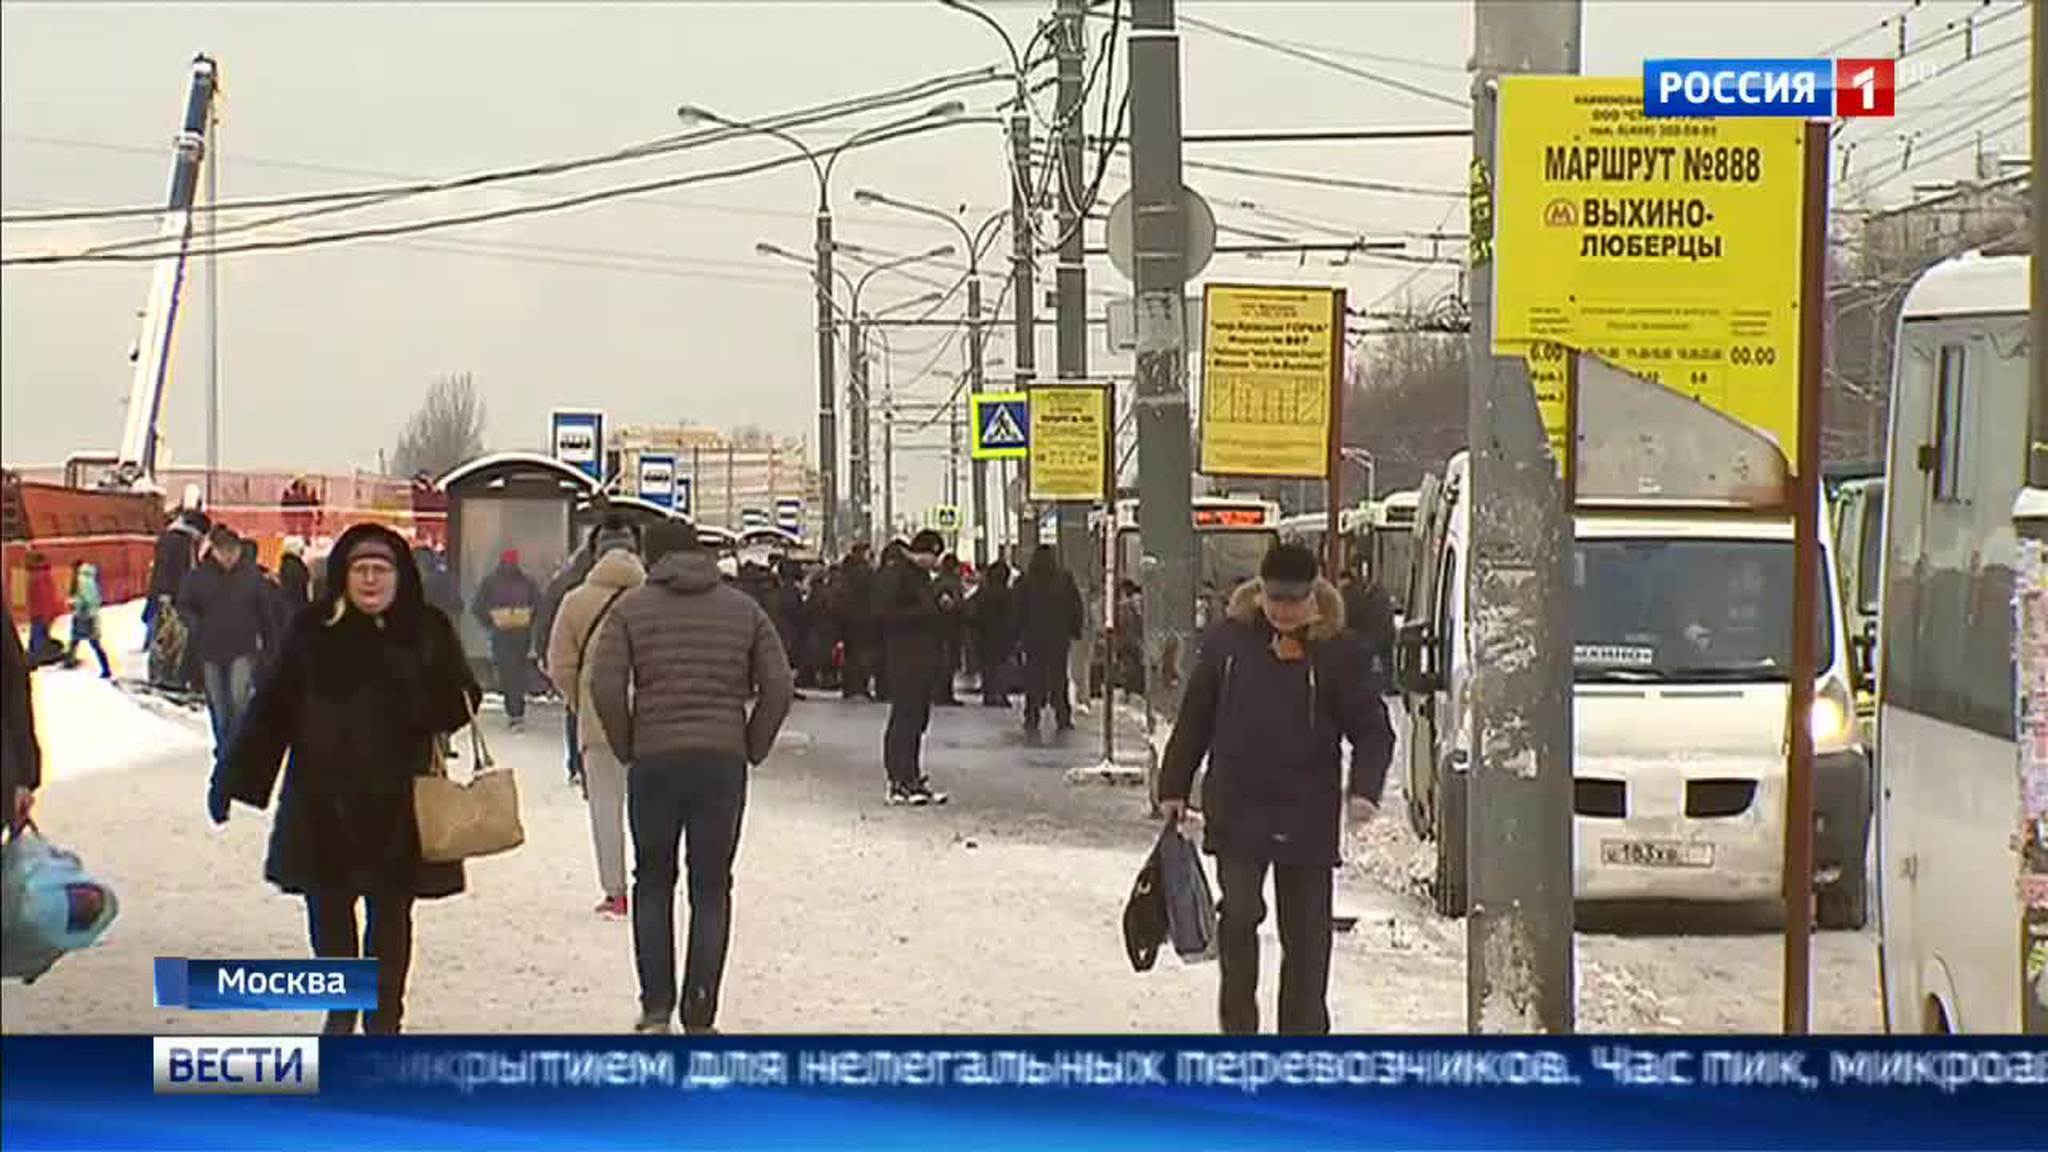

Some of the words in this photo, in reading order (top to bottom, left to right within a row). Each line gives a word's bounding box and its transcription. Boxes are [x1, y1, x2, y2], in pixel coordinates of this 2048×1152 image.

[1545, 146, 1676, 181] МАРШРУТ
[1683, 146, 1762, 182] №888
[1583, 199, 1714, 228] ВЫХИНО-
[1580, 235, 1723, 262] ЛЮБЕРЦЫ
